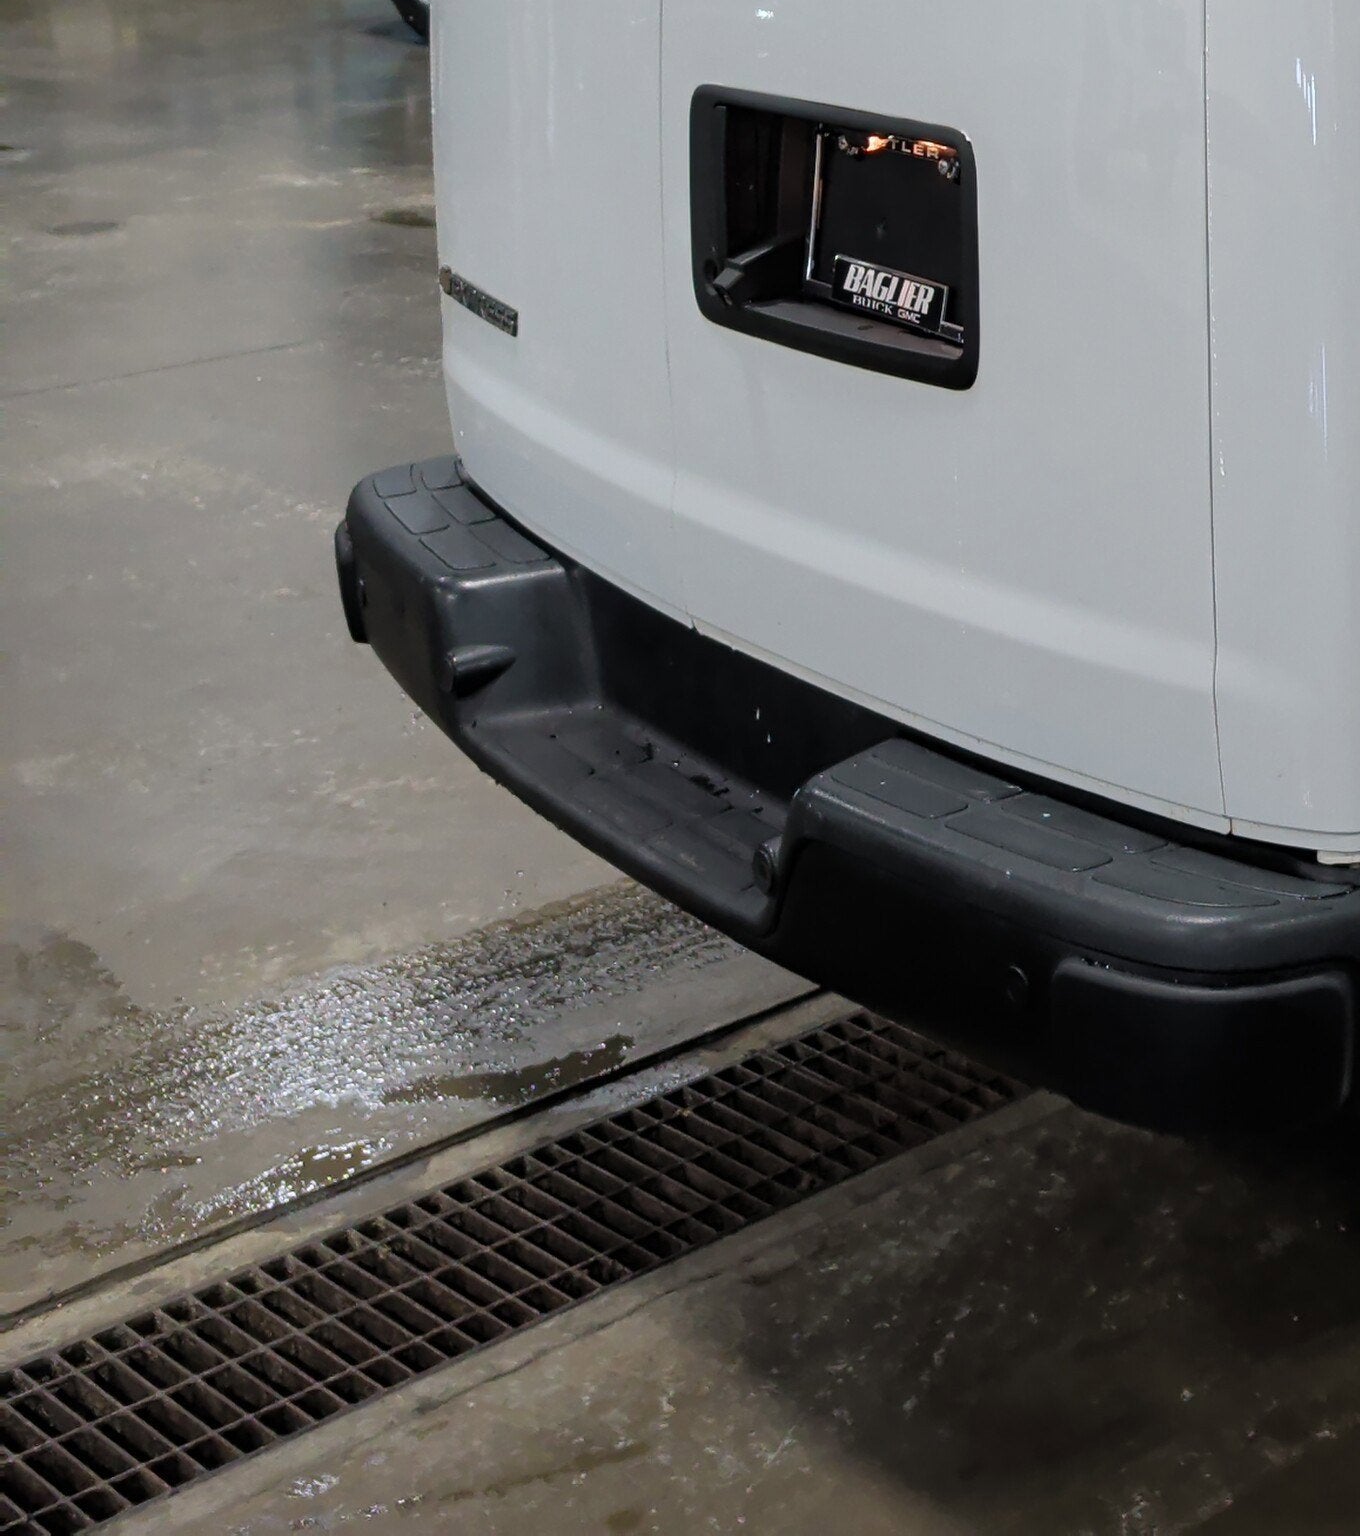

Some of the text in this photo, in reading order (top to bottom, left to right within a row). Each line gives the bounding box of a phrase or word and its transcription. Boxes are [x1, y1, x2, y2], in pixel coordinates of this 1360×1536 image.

[874, 137, 940, 159] TLER
[843, 264, 935, 315] BAGLIER
[852, 294, 921, 324] BUICK GMC
